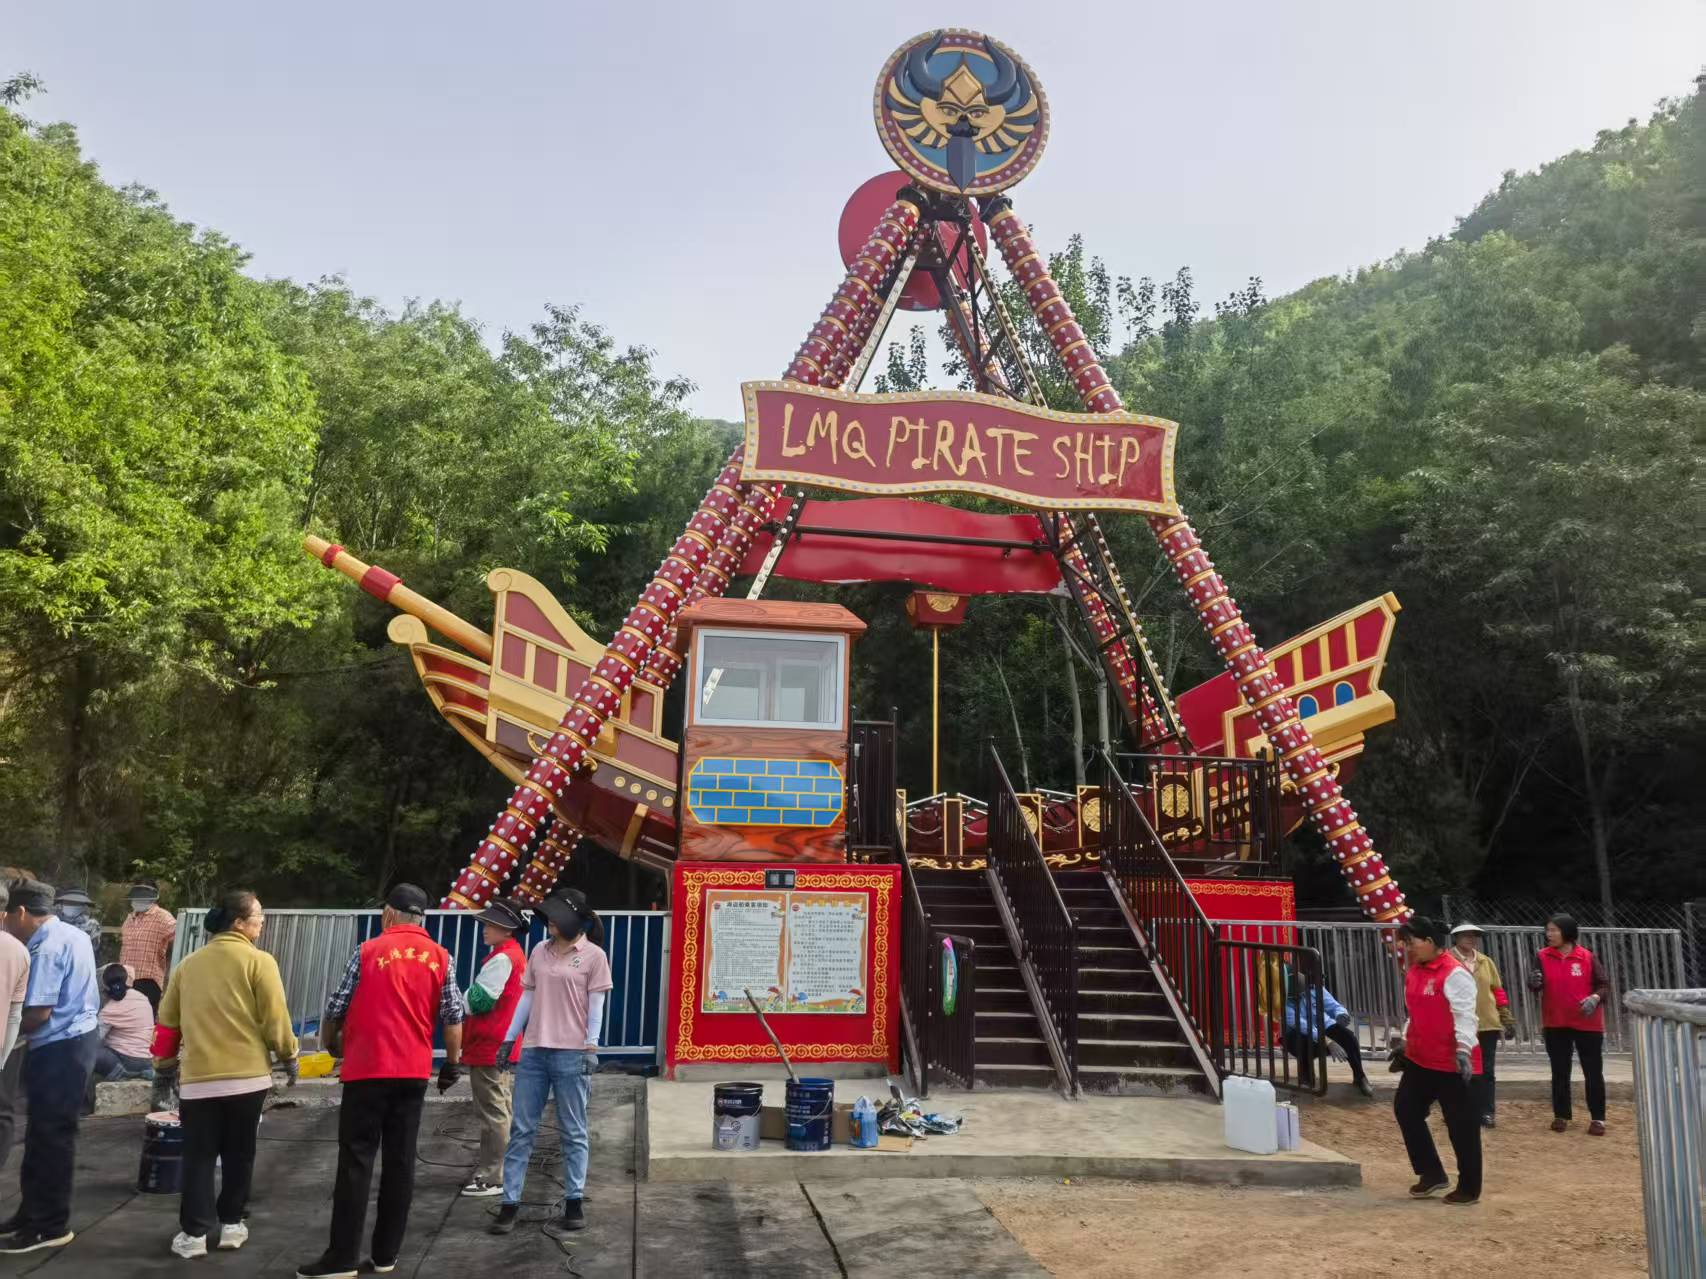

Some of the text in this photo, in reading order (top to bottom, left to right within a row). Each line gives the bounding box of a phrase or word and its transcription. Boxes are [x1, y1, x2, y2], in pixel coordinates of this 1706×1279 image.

[782, 403, 1140, 487] LMQ PIRATE SHIP
